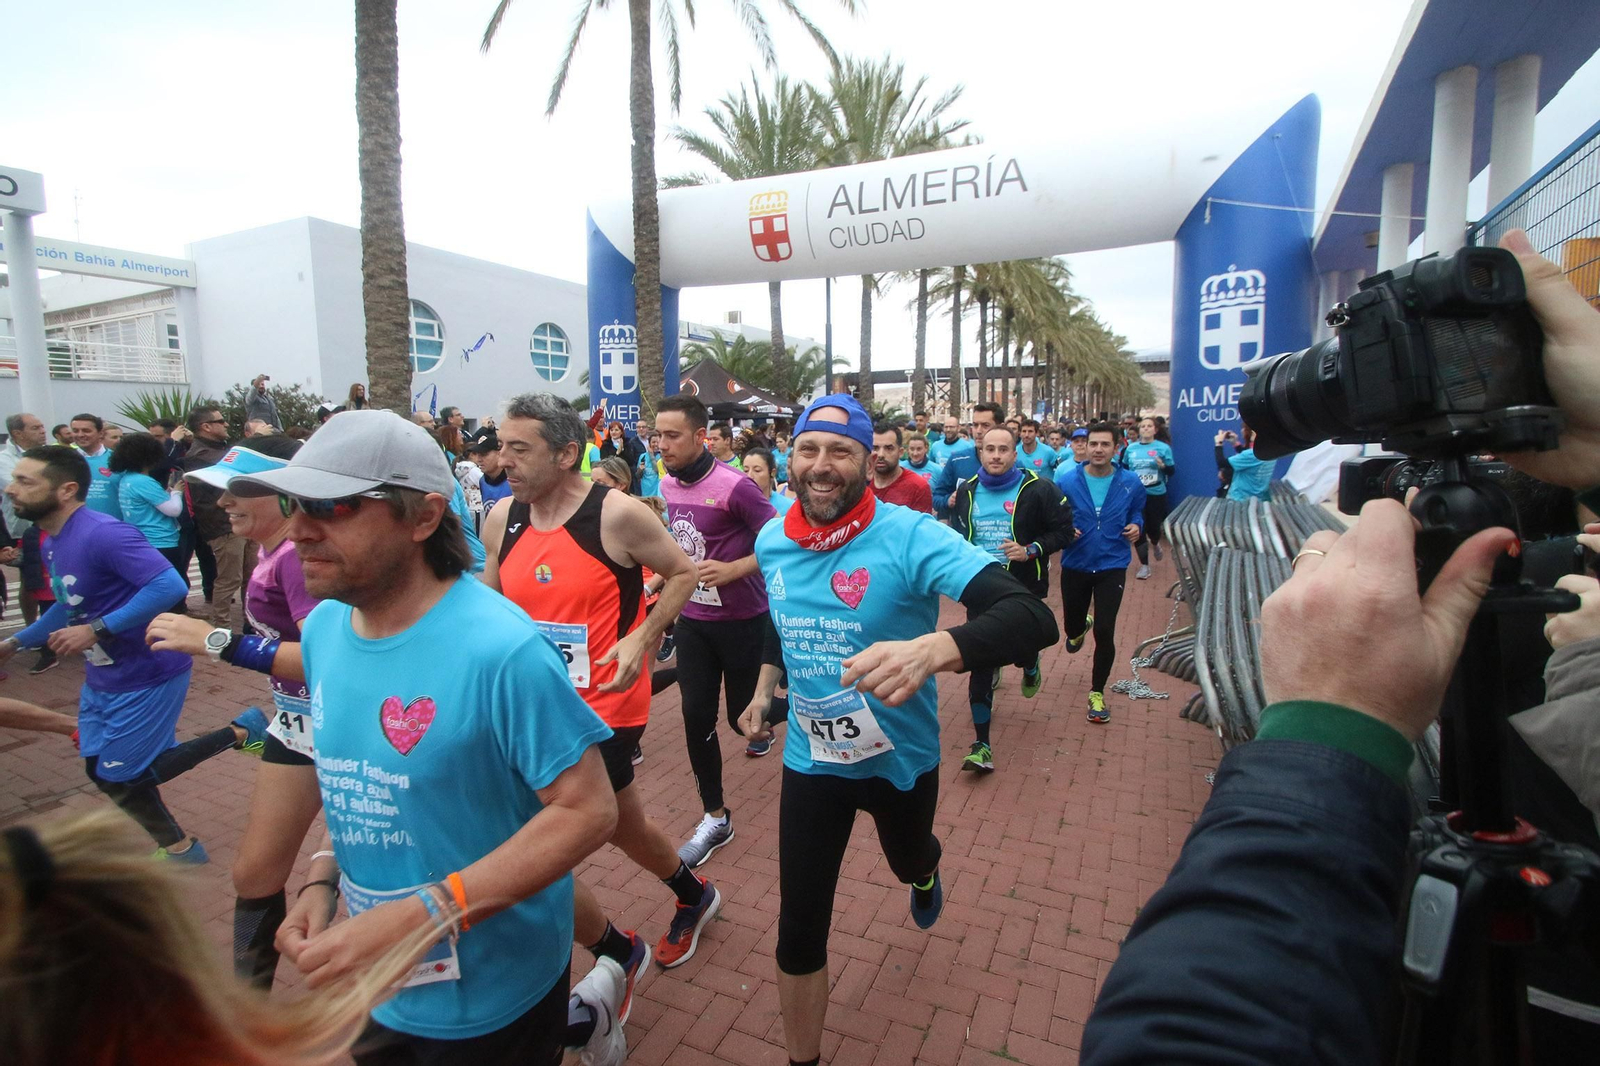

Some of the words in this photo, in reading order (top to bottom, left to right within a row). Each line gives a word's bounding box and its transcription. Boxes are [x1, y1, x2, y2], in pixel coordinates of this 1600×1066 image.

[827, 154, 1028, 219] ALMERÍA
[828, 217, 925, 249] CIUDAD
[74, 251, 116, 268] Bahía
[121, 259, 190, 278] Almeriport
[1176, 383, 1245, 409] ALME
[780, 614, 817, 628] Runner
[819, 616, 863, 633] Fashion
[781, 628, 823, 642] Carrera
[825, 632, 848, 644] azul
[799, 641, 812, 653] el
[813, 642, 854, 655] autismo
[800, 662, 826, 680] nada
[823, 661, 838, 676] te
[386, 715, 427, 732] fashiOn
[810, 716, 861, 741] 473
